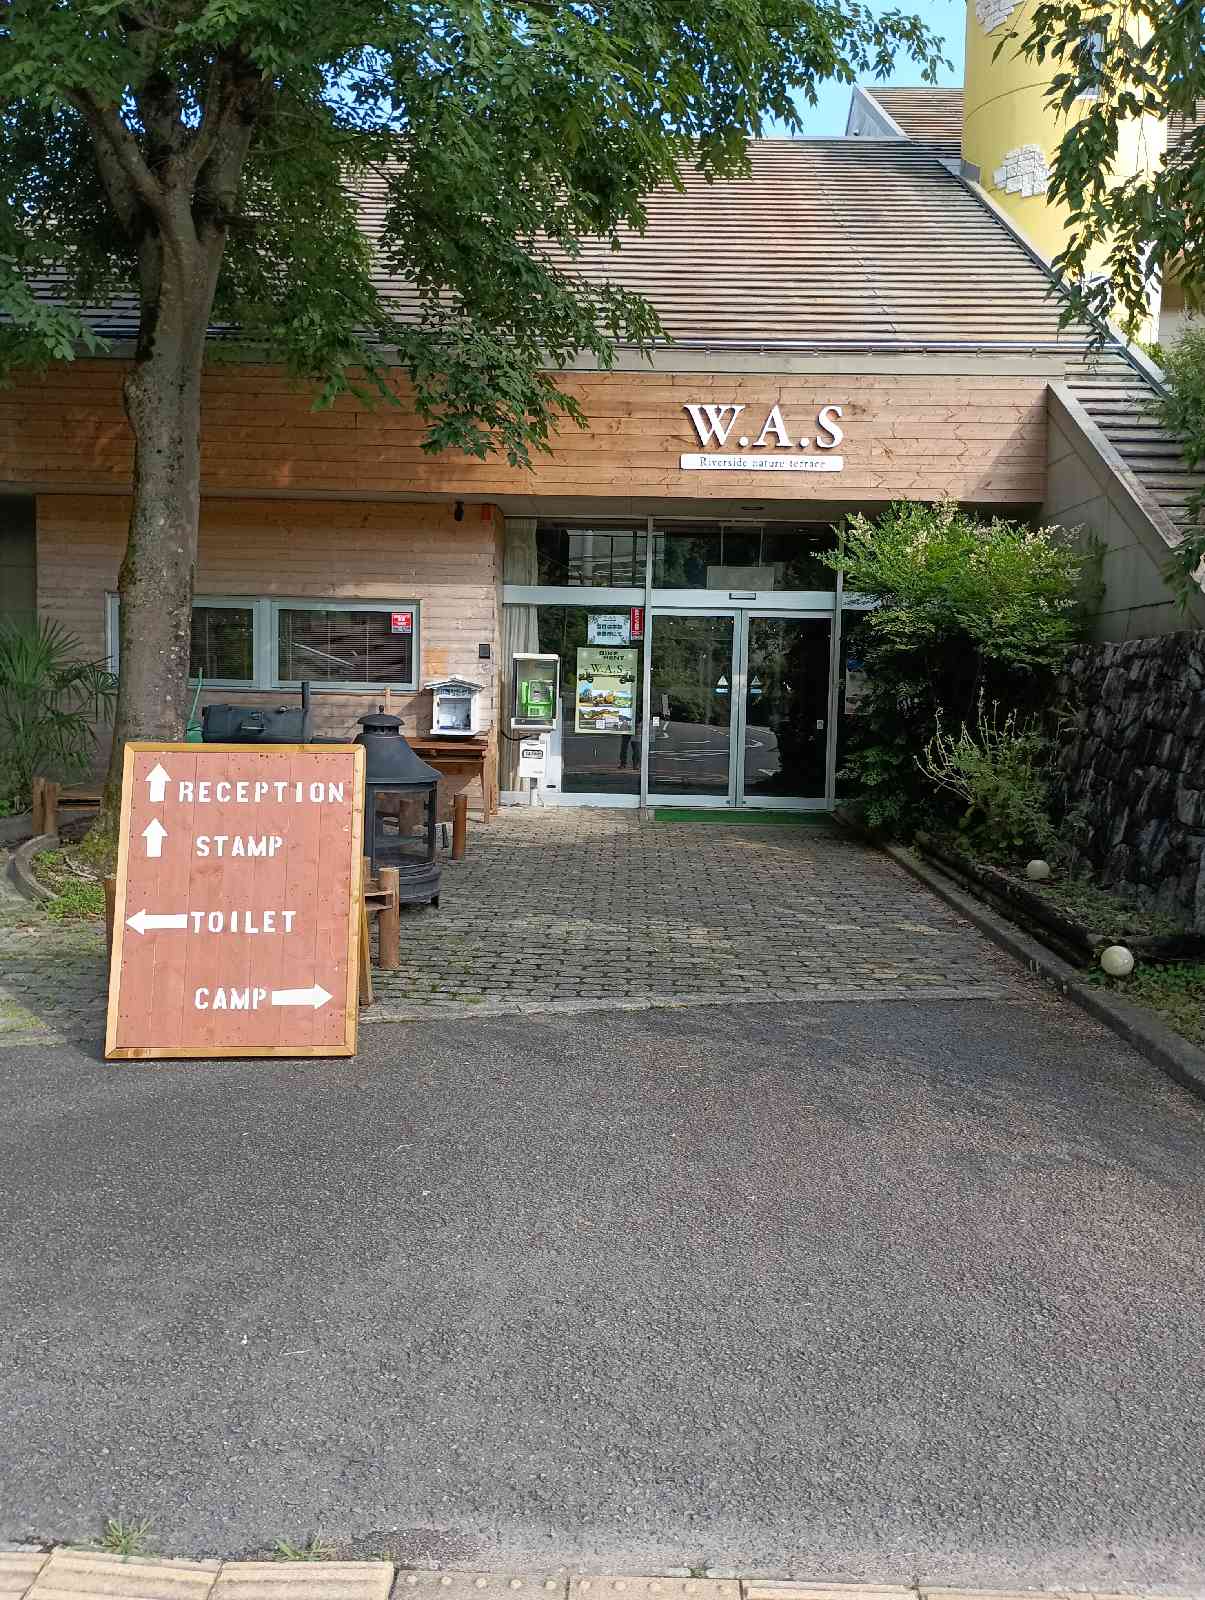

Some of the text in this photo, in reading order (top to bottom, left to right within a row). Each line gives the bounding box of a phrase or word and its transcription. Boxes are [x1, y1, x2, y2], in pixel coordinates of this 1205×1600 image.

[683, 404, 844, 448] W.A.S
[699, 456, 825, 469] Riverside nature terrace
[178, 781, 344, 803] RECEPTION
[196, 835, 283, 857] STAMP
[191, 911, 297, 934] TOILET
[194, 987, 267, 1010] CAMP
